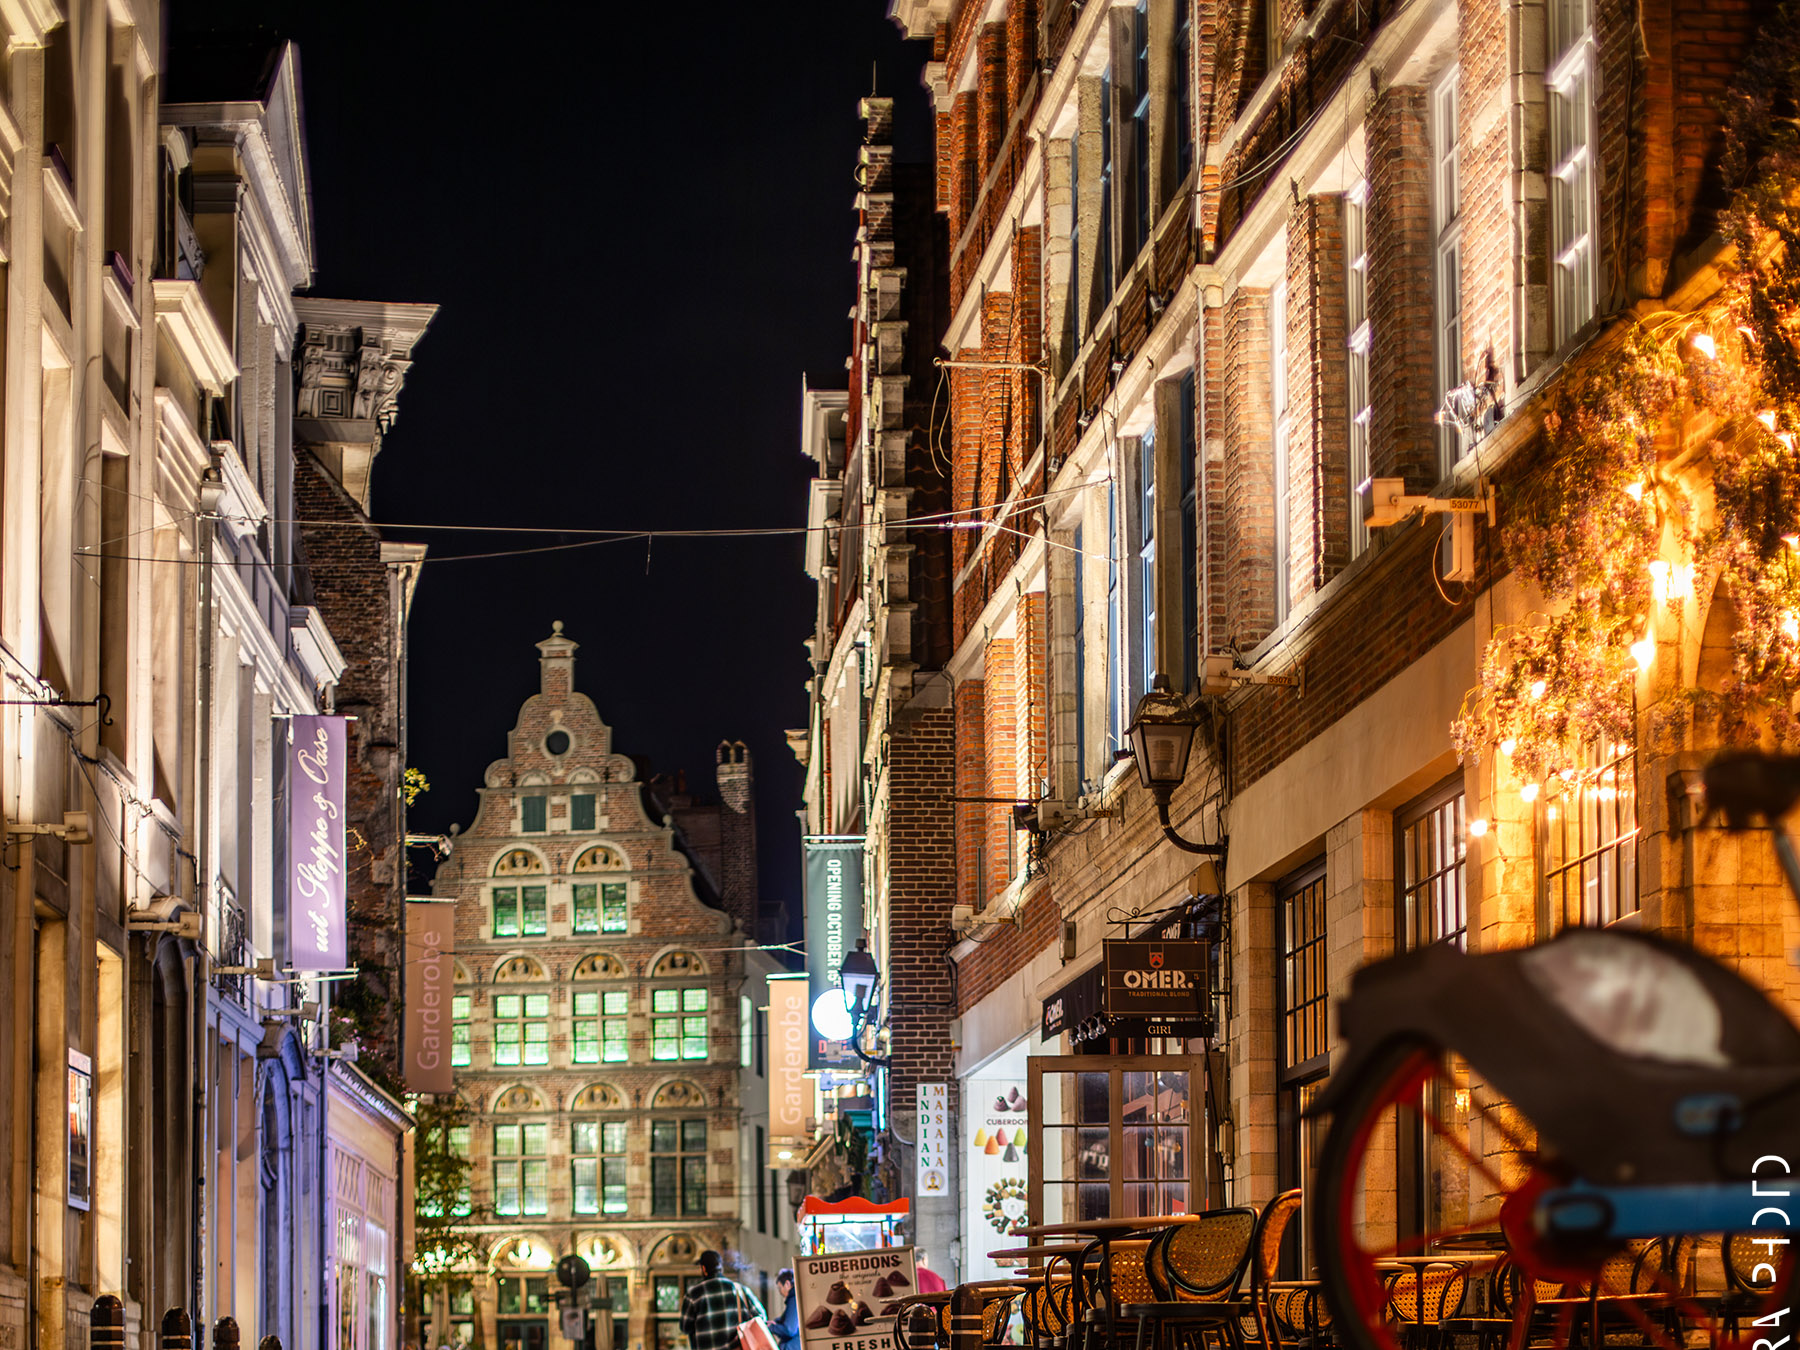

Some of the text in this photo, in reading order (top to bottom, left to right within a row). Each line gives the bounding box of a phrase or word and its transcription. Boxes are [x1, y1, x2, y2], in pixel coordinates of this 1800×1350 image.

[1451, 500, 1479, 509] 53077
[297, 727, 329, 785] Oase
[297, 816, 339, 908] Steppe
[826, 859, 842, 911] OPENING
[307, 910, 330, 953] uit
[826, 913, 842, 967] OCTOBER
[416, 930, 441, 1071] Garderobe
[1147, 1025, 1172, 1035] GIRI
[779, 995, 803, 1126] Garderobe
[920, 1086, 930, 1167] INDIAN
[933, 1086, 945, 1168] MASALA
[808, 1254, 902, 1275] CUBERDONS
